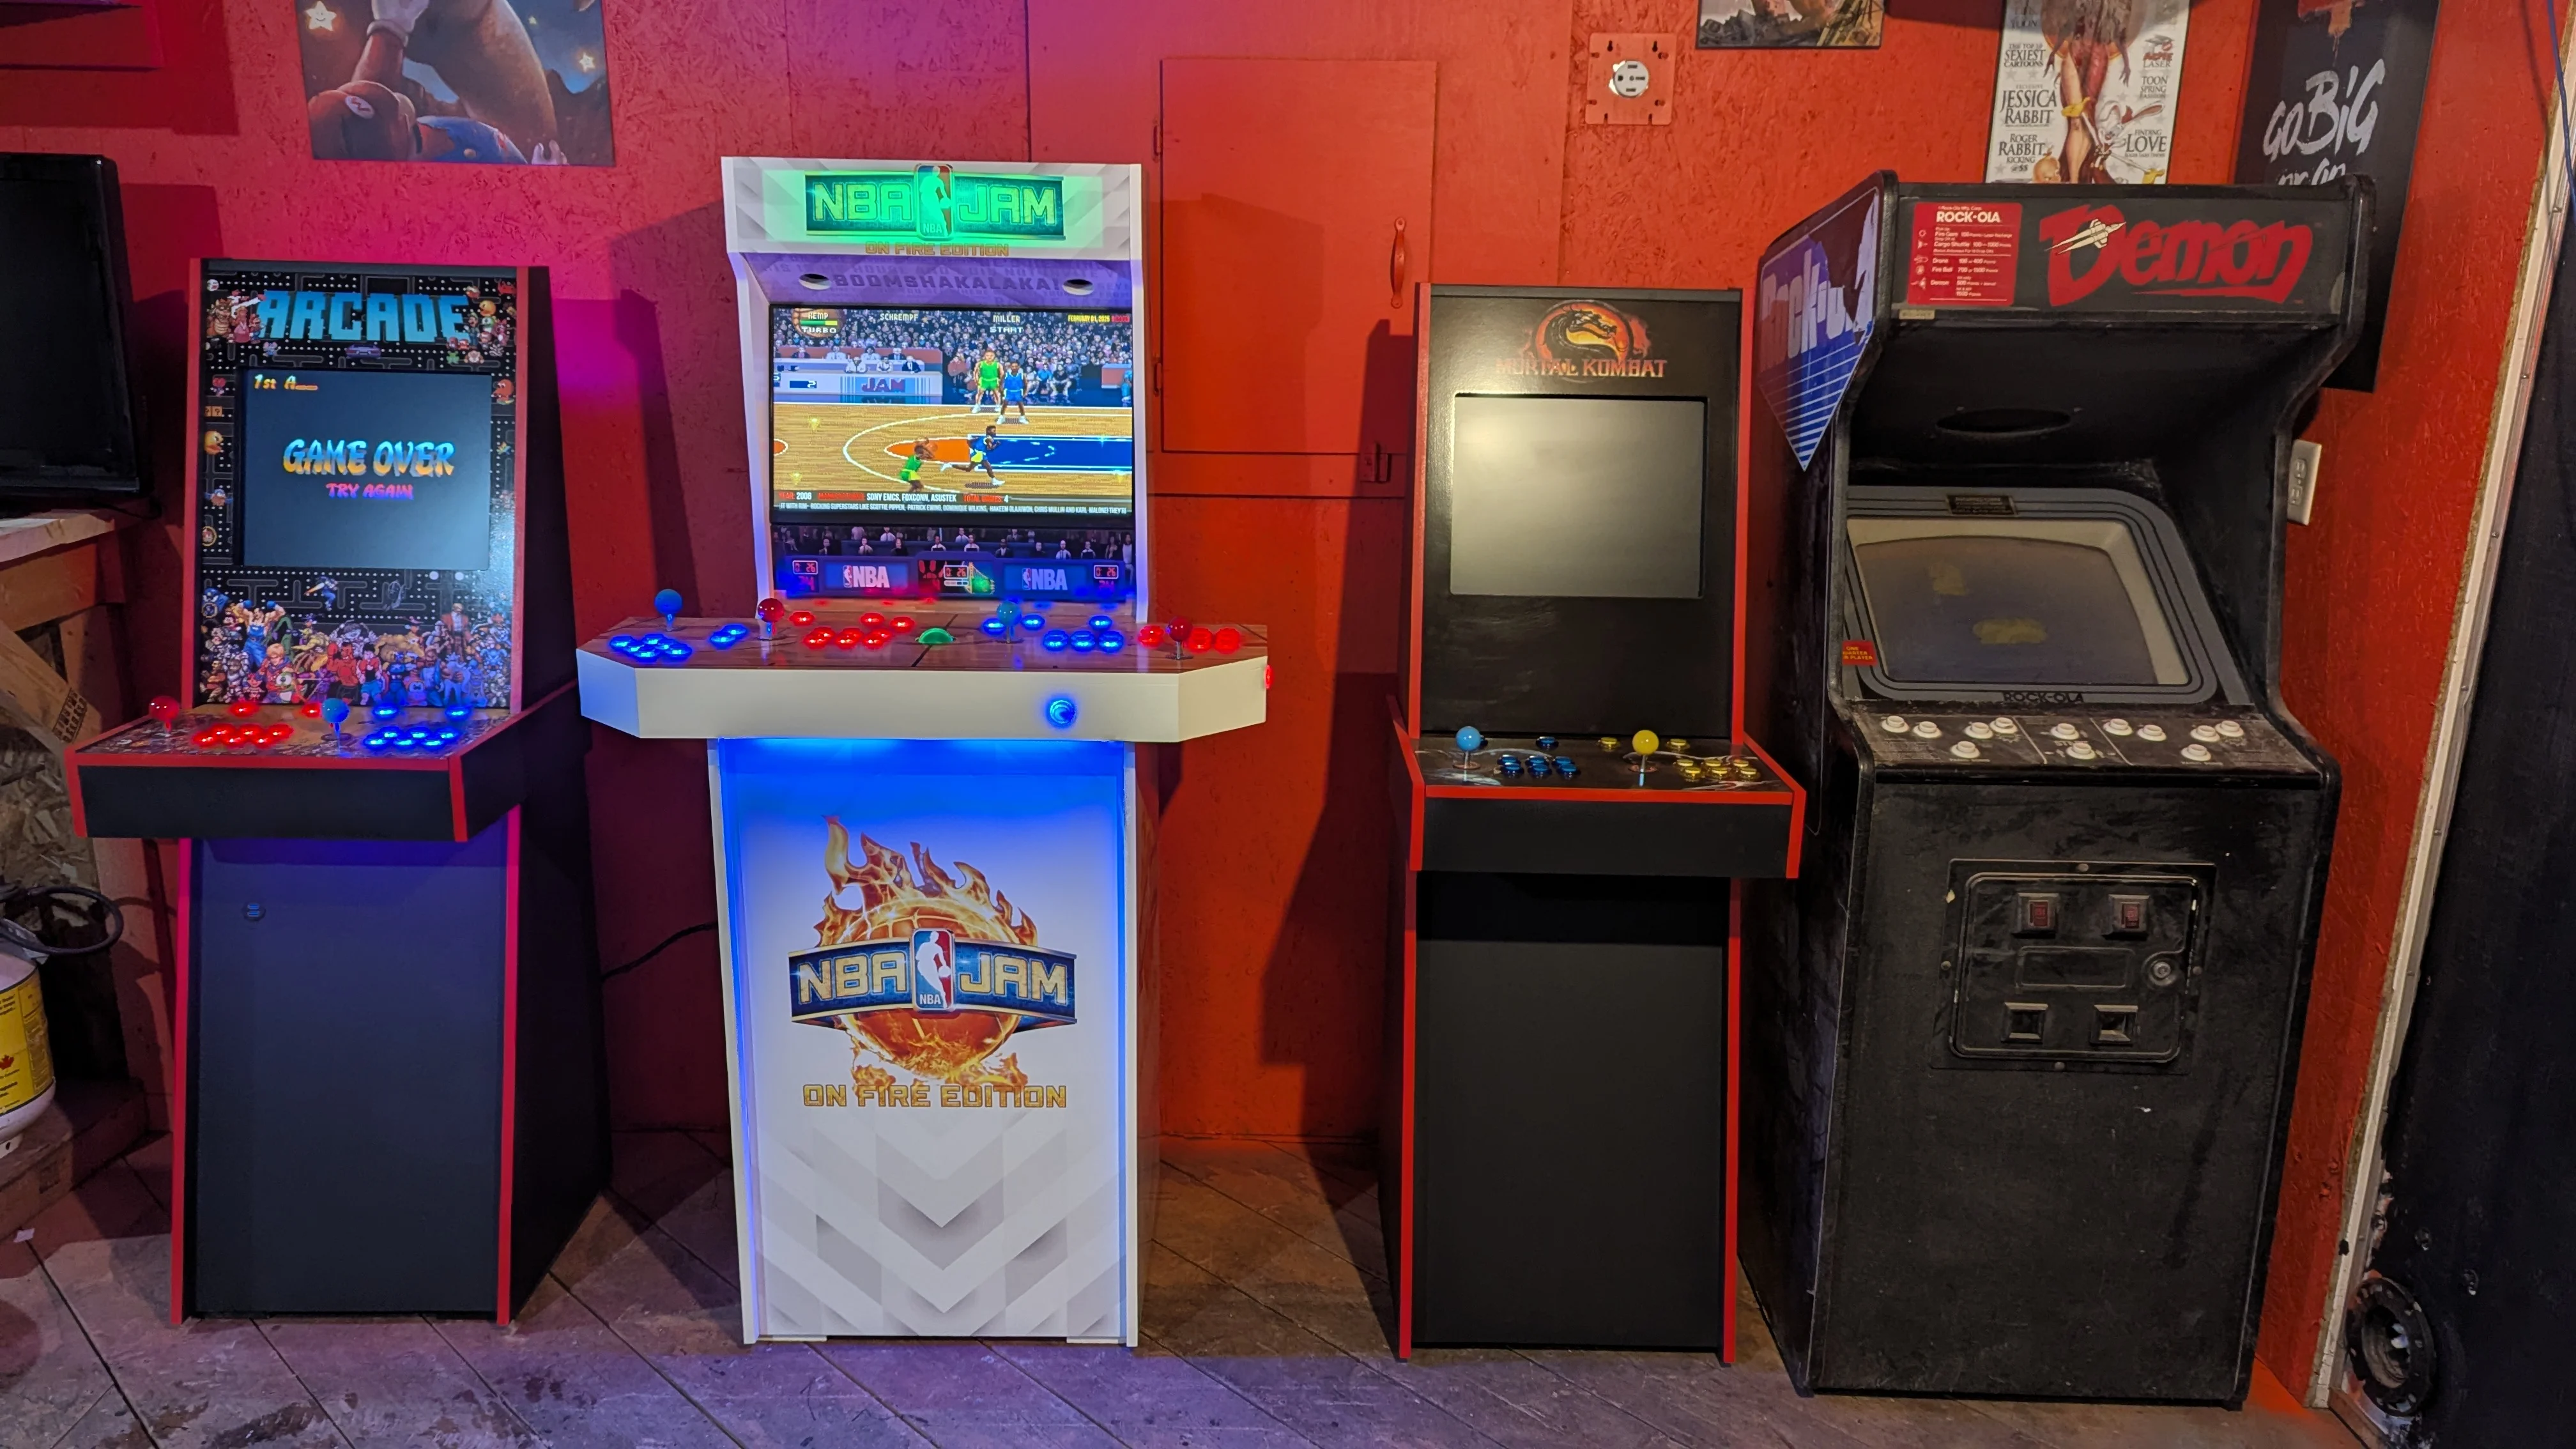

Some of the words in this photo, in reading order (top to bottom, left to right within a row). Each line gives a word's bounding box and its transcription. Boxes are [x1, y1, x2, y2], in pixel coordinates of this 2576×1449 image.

[2005, 49, 2046, 61] SEXIEST
[2143, 59, 2170, 68] LASER
[2142, 76, 2168, 84] TOON
[1999, 90, 2057, 112] JESSICA
[2004, 108, 2054, 124] RABBIT
[2010, 134, 2037, 142] ROGER
[2126, 134, 2167, 152] LOVE
[1998, 141, 2045, 155] RABBIT
[812, 182, 912, 222] NBA
[958, 185, 1056, 226] JAM
[923, 223, 943, 234] NBA
[865, 241, 890, 255] ON
[894, 241, 935, 256] FIRE
[940, 243, 1009, 257] EDITION
[2040, 204, 2314, 307] Demon
[834, 274, 1059, 291] BOOMSHAKALAKA!
[257, 290, 469, 343] ARCADE
[880, 313, 919, 321] SCHREMPF
[993, 314, 1020, 323] MILLER
[1496, 358, 1579, 376] MORTAL
[1582, 358, 1667, 378] KOMBAT
[254, 374, 276, 390] 1st
[862, 377, 906, 392] JAM
[283, 439, 367, 476] GAME
[372, 440, 455, 477] OVER
[326, 483, 358, 498] TRY
[362, 484, 414, 501] AGAIN
[796, 491, 812, 500] 2006
[866, 493, 882, 501] SONY
[883, 493, 901, 502] EMCS,
[901, 494, 930, 502] FOXCONN,
[931, 494, 957, 502] ASUSTEK
[963, 493, 980, 502] TOTAL
[1004, 494, 1009, 503] 4
[854, 565, 890, 588] NBA
[1032, 569, 1068, 590] NBA
[2003, 692, 2085, 703] ROCK-OLA
[797, 952, 907, 1005] NBA
[959, 952, 1068, 1006] JAM
[920, 994, 941, 1005] NBA
[802, 1085, 847, 1107] ON
[858, 1085, 931, 1107] FIRE
[940, 1085, 1066, 1108] EDITION
